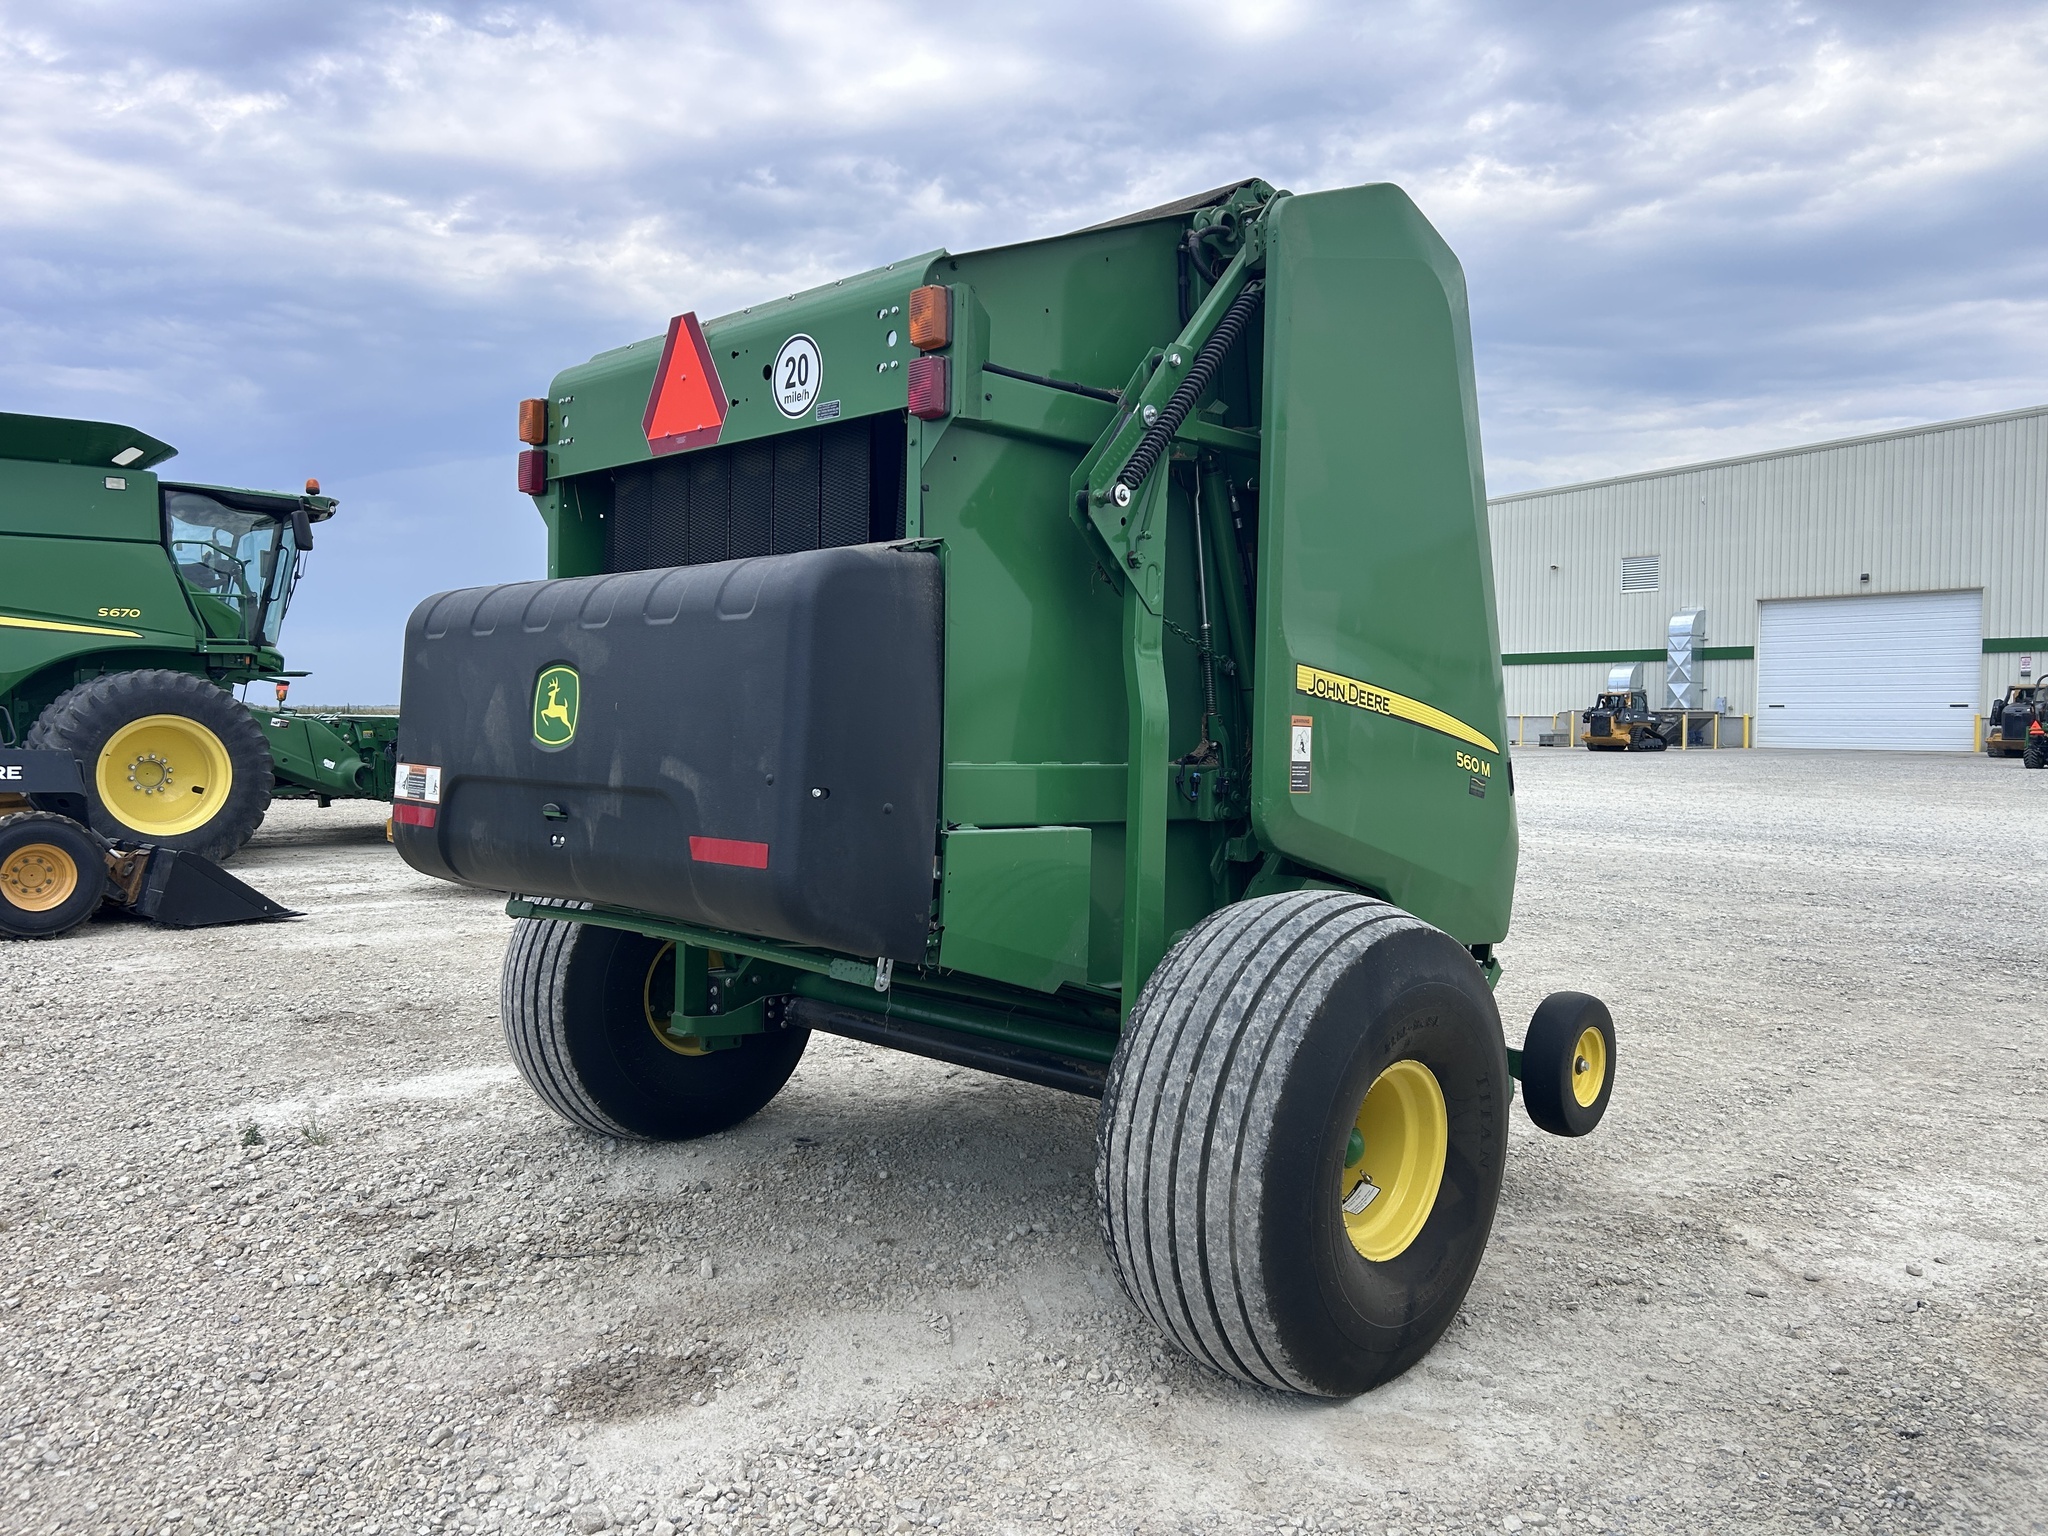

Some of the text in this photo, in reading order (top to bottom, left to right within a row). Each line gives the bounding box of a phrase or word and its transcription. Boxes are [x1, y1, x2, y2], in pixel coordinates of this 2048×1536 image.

[784, 353, 809, 390] 20
[784, 389, 810, 404] mile/h
[97, 607, 141, 618] S670
[1307, 673, 1390, 712] JOHN DEERE
[1456, 750, 1491, 778] 560 M
[1475, 1071, 1494, 1169] TITAN
